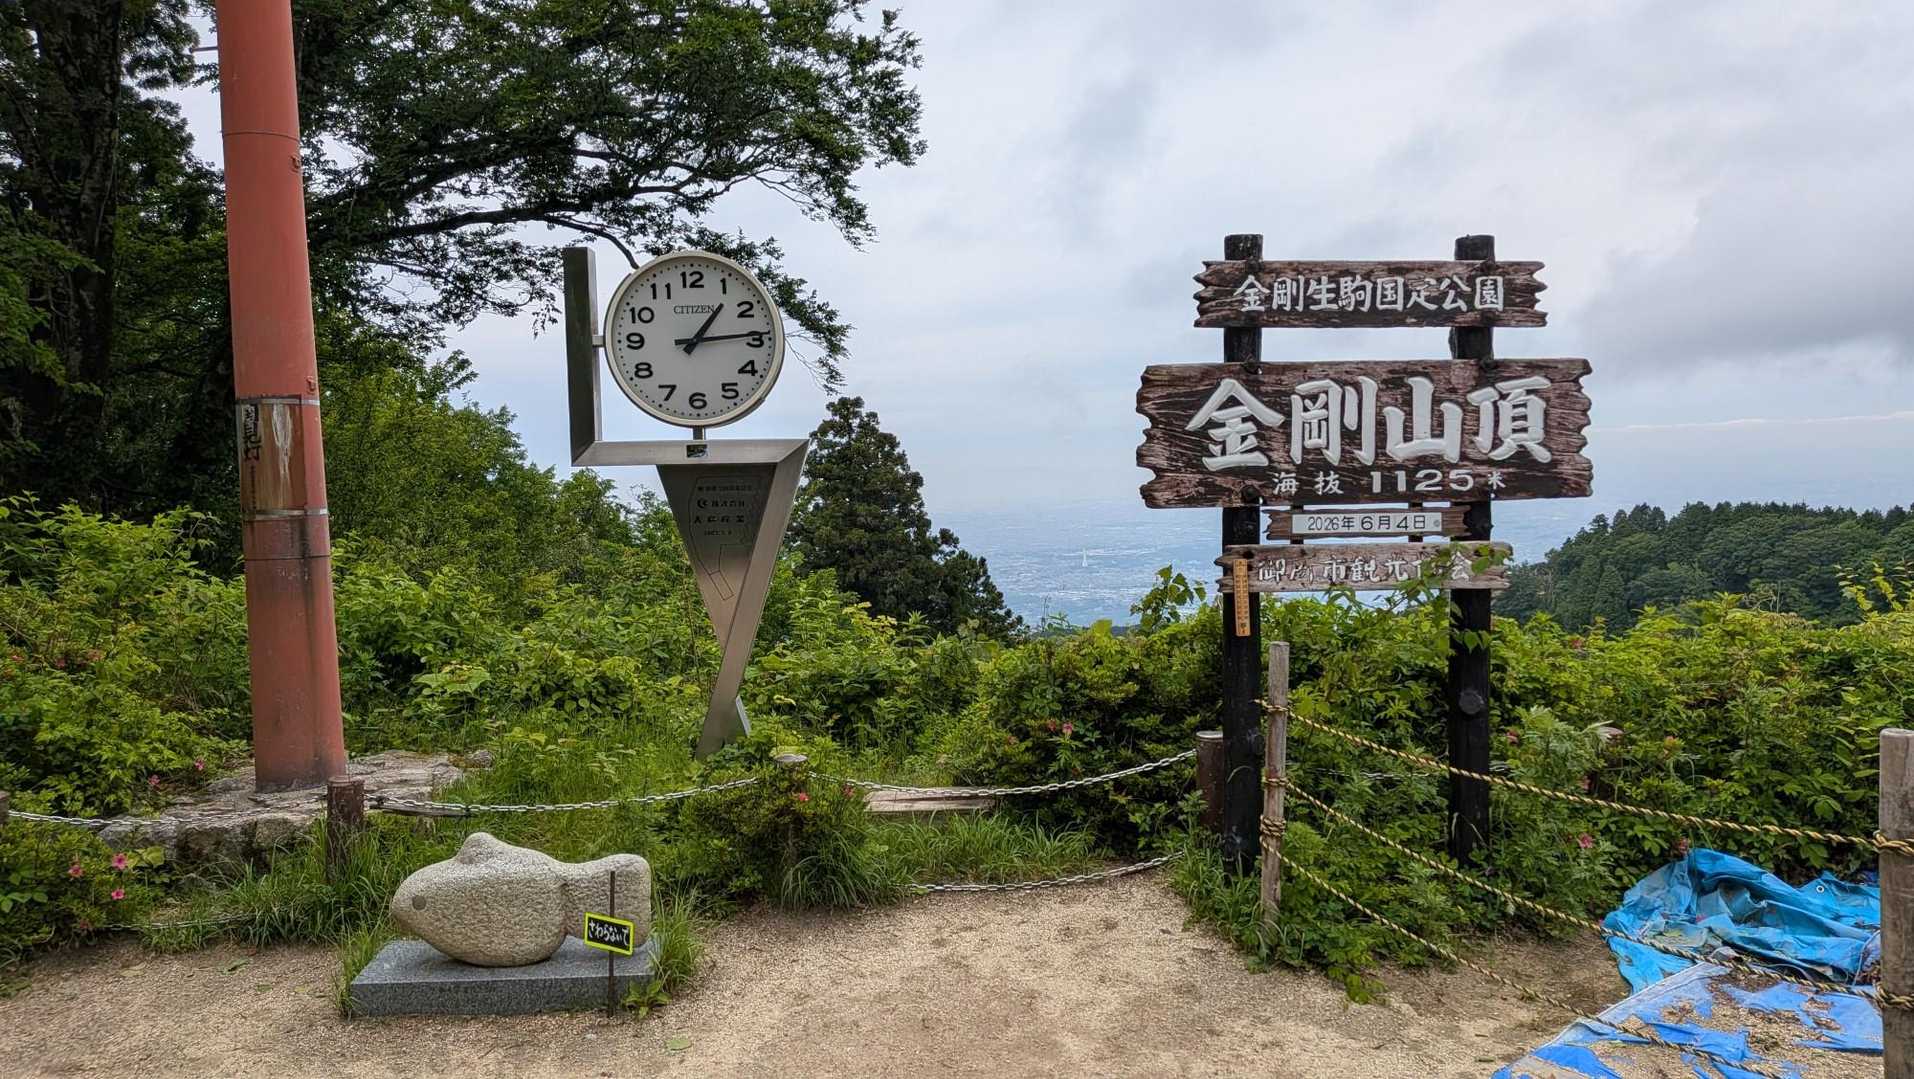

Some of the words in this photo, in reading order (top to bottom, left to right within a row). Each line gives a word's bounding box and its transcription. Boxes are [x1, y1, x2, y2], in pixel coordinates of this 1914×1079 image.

[680, 271, 704, 288] 12
[720, 278, 727, 295] 1
[650, 283, 671, 300] 11
[1234, 274, 1506, 314] 金剛生駒国定公園
[629, 307, 654, 324] 10
[673, 304, 716, 315] CITIZEN
[737, 301, 754, 318] 2
[626, 333, 645, 350] 9
[747, 331, 764, 348] 3
[634, 363, 653, 379] 8
[738, 360, 758, 377] 4
[658, 385, 677, 401] 7
[721, 383, 739, 400] 5
[688, 393, 707, 410] 6
[1186, 375, 1552, 471] 金剛山頂
[1258, 552, 1473, 584] 御所市観光会
